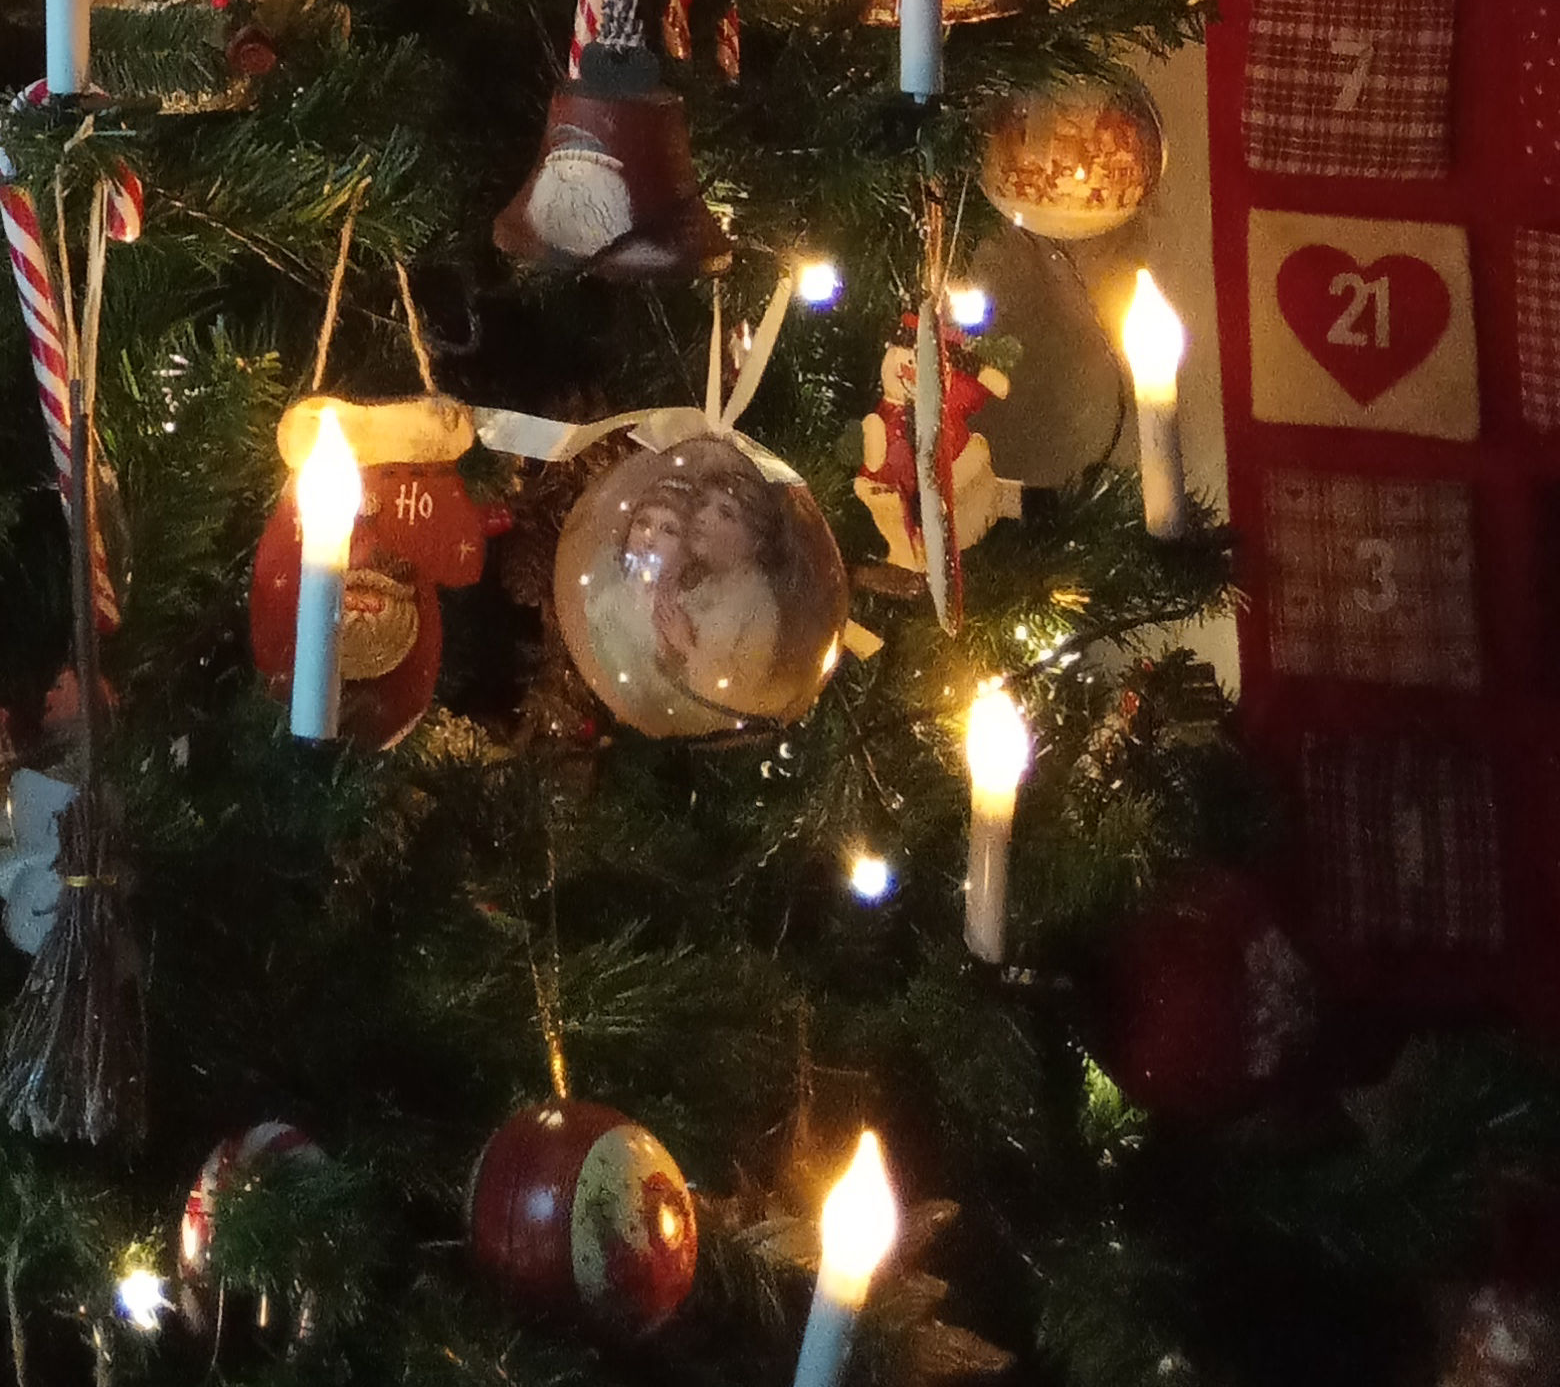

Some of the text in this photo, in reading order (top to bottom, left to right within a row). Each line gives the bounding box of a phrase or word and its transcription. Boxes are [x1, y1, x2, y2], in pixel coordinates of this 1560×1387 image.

[1329, 26, 1376, 112] 7
[1326, 272, 1392, 349] 21
[1353, 538, 1400, 614] 3
